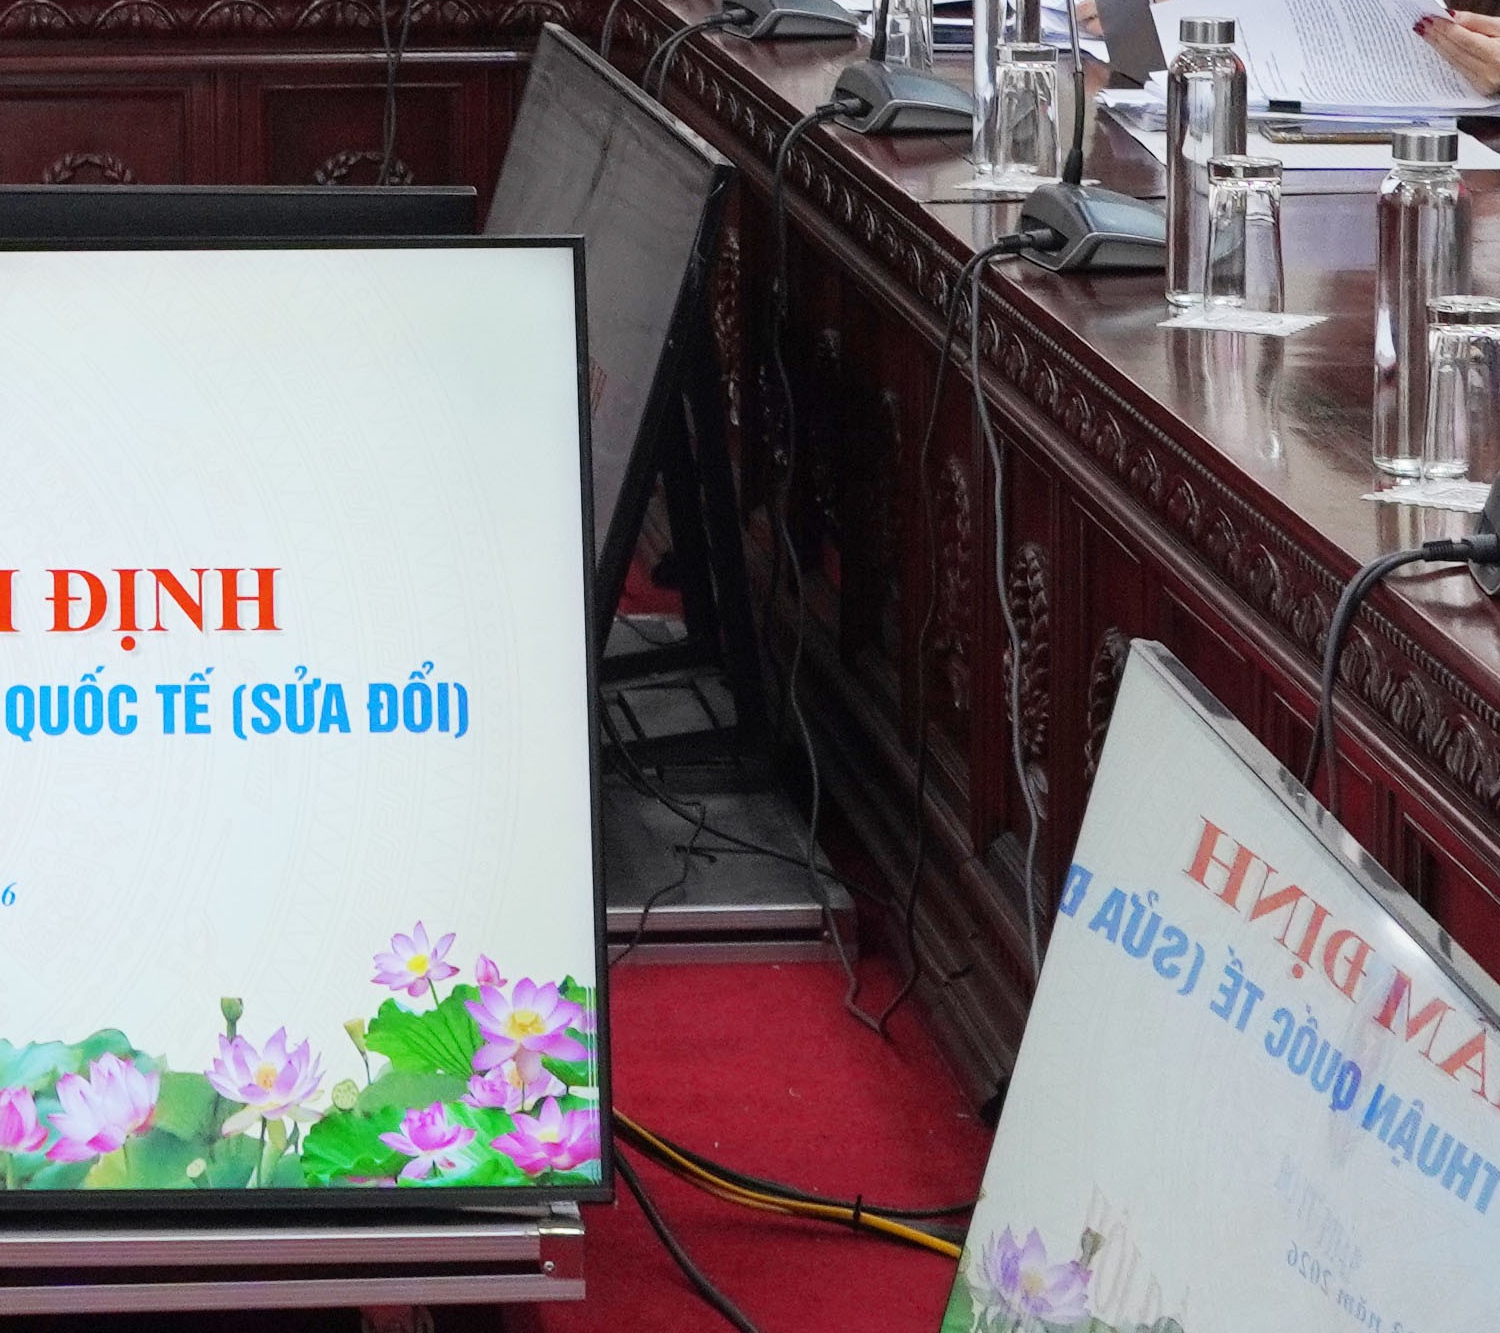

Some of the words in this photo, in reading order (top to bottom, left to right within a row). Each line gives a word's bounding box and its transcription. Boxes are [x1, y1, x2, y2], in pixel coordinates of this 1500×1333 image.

[46, 567, 279, 652] ĐỊNH
[4, 664, 139, 743] QUỐC
[154, 666, 215, 736] TẾ
[231, 664, 352, 741] (SỬA
[365, 661, 470, 741] ĐỔI)
